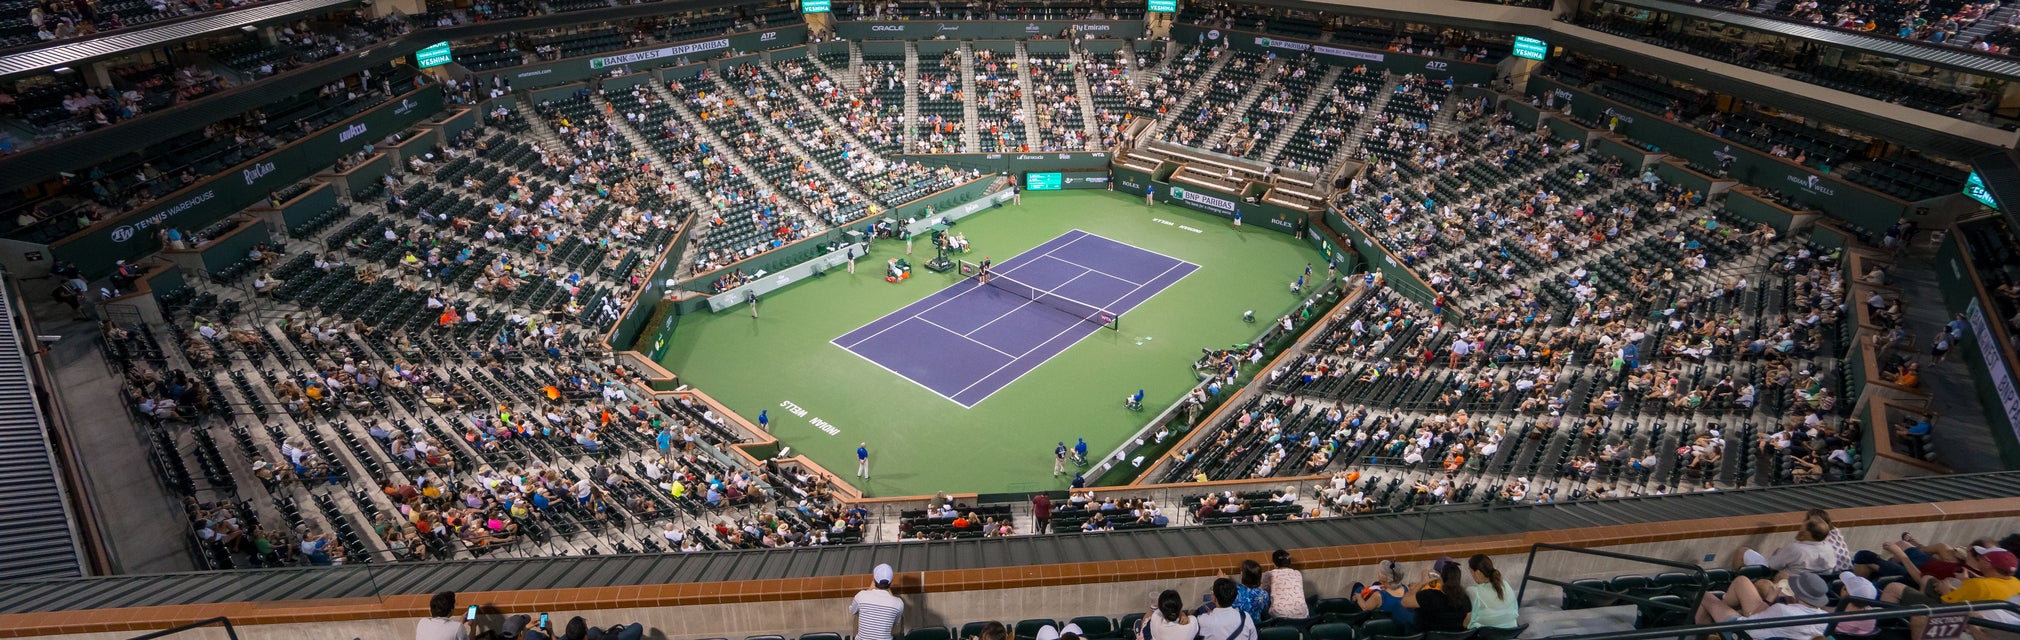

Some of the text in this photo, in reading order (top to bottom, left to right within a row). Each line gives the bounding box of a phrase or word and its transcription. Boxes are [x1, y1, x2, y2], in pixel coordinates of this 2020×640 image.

[761, 32, 776, 40] ATP
[604, 56, 629, 66] BANK
[636, 50, 660, 60] WEST
[672, 45, 690, 55] BNP
[692, 40, 728, 52] PARIBAS
[1425, 61, 1447, 69] ATP
[517, 69, 552, 78] wtatennis.com
[1555, 88, 1573, 100] Hertz
[1122, 180, 1140, 189] ROLEX
[1787, 175, 1808, 186] INDIAN
[1815, 185, 1834, 196] WELLS
[1185, 192, 1232, 209] BNP PARIBAS
[134, 191, 215, 231] TENNIS WAREHOUSE
[1271, 218, 1293, 228] ROLEX
[1929, 616, 1965, 625] SECTION
[1926, 624, 1960, 638] 417
